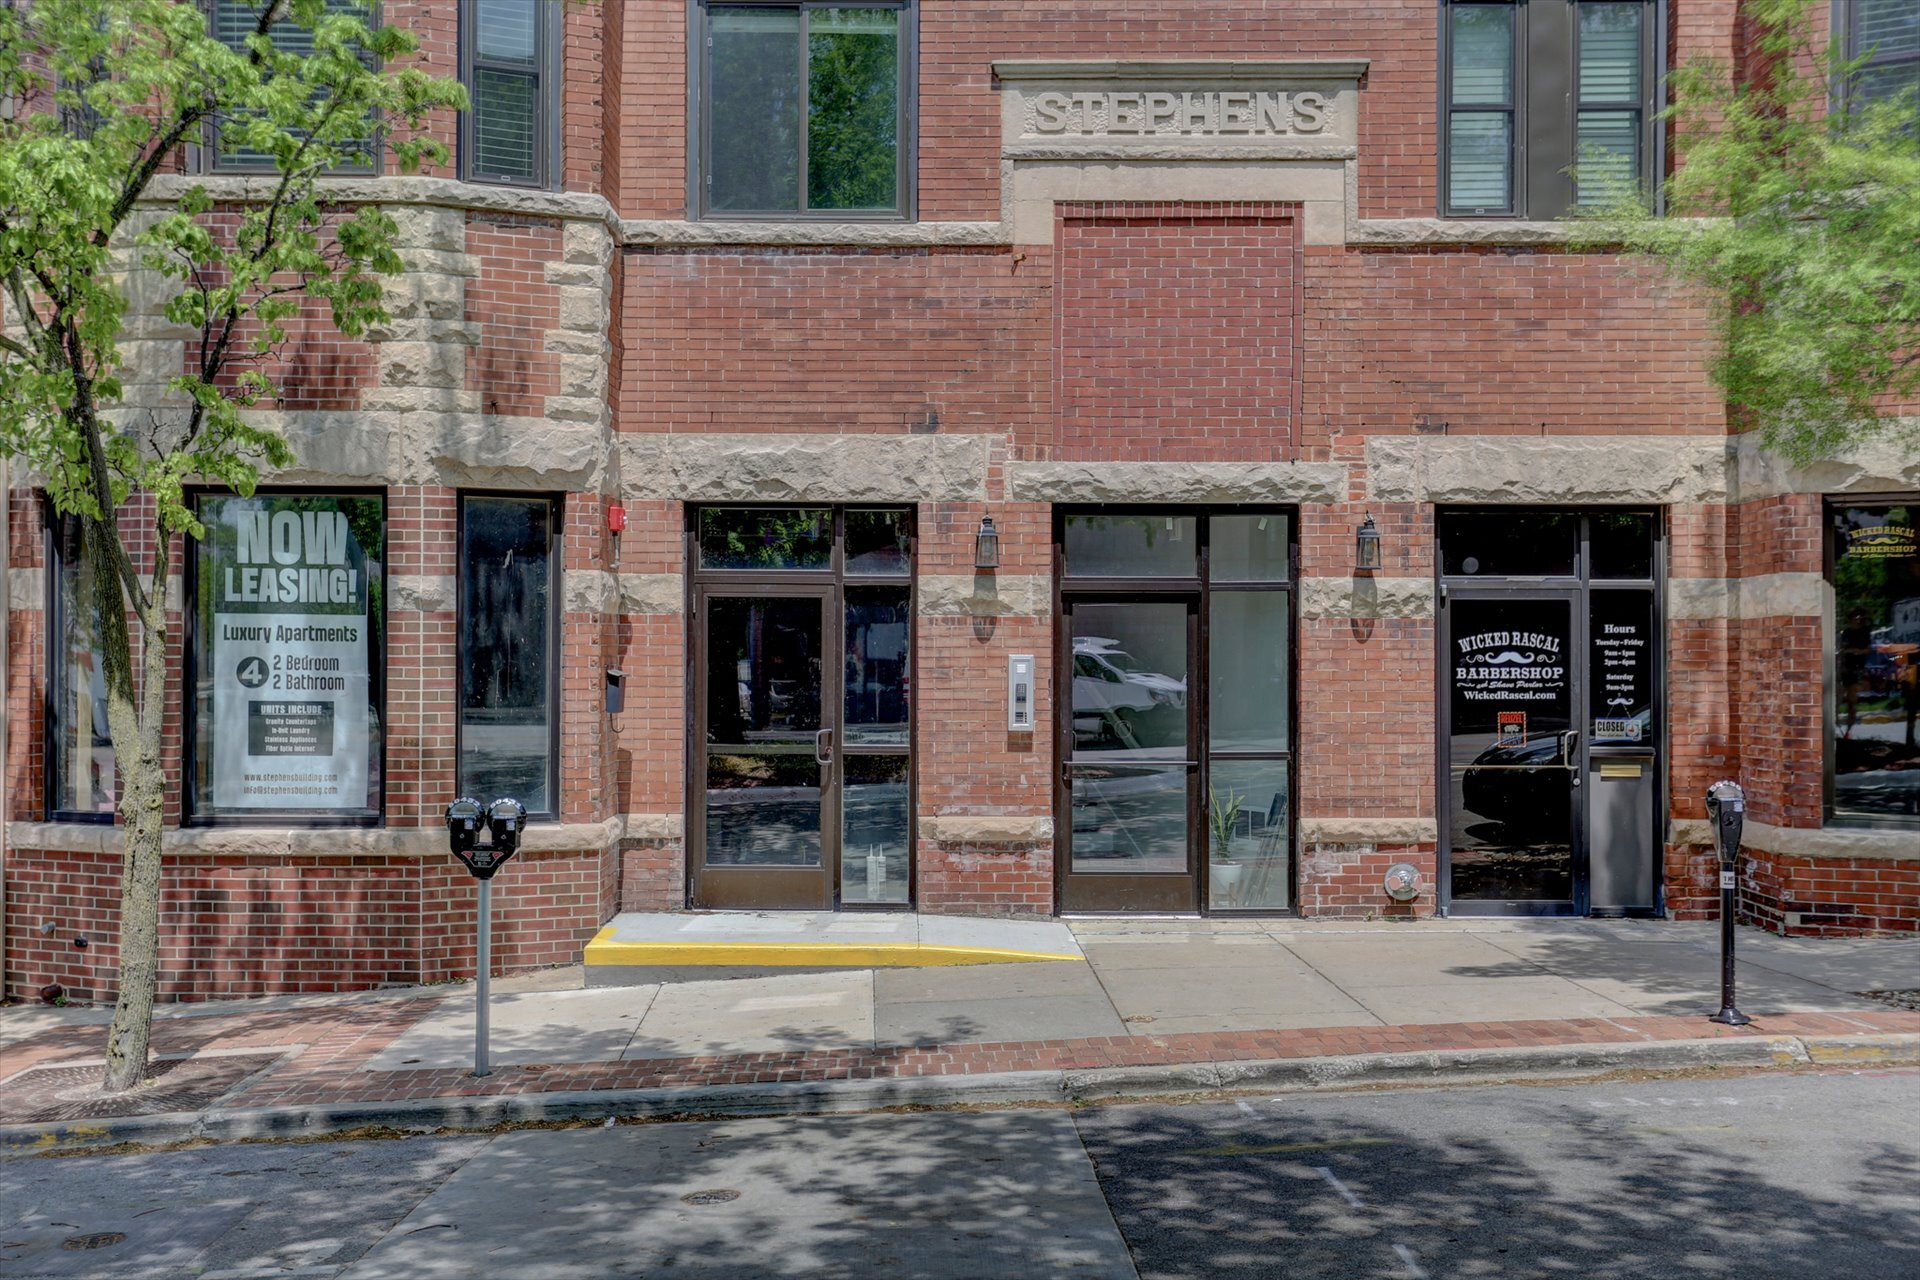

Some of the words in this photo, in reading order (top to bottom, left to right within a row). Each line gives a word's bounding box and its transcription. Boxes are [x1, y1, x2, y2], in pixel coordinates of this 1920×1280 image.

[1035, 92, 1325, 136] STEPHENS
[237, 510, 349, 565] NOW
[1849, 526, 1883, 539] WICKED
[1884, 526, 1915, 538] RASCAL
[225, 567, 357, 603] LEASING!
[224, 624, 271, 644] Luxury
[276, 625, 358, 644] Apartments
[1604, 624, 1636, 634] Hours
[1458, 631, 1510, 653] WICKED
[1511, 631, 1560, 653] RASCAL
[273, 654, 281, 670] 2
[286, 655, 339, 671] Bedroom
[241, 659, 262, 685] 4
[1456, 667, 1564, 679] BARBERSHOP
[273, 674, 281, 689] 2
[286, 674, 345, 690] Bathroom
[1464, 691, 1556, 700] WickedRascal.com
[261, 705, 285, 714] UNITS
[288, 705, 322, 714] INCLUDE
[286, 718, 316, 726] Countertops
[1597, 721, 1625, 732] CLOSED
[290, 727, 310, 735] Laundry
[290, 736, 317, 744] Appliances
[280, 745, 293, 753] Optic
[244, 773, 337, 783] www.stephensbuilding.com
[244, 785, 337, 796] info@stephensbuilding.com
